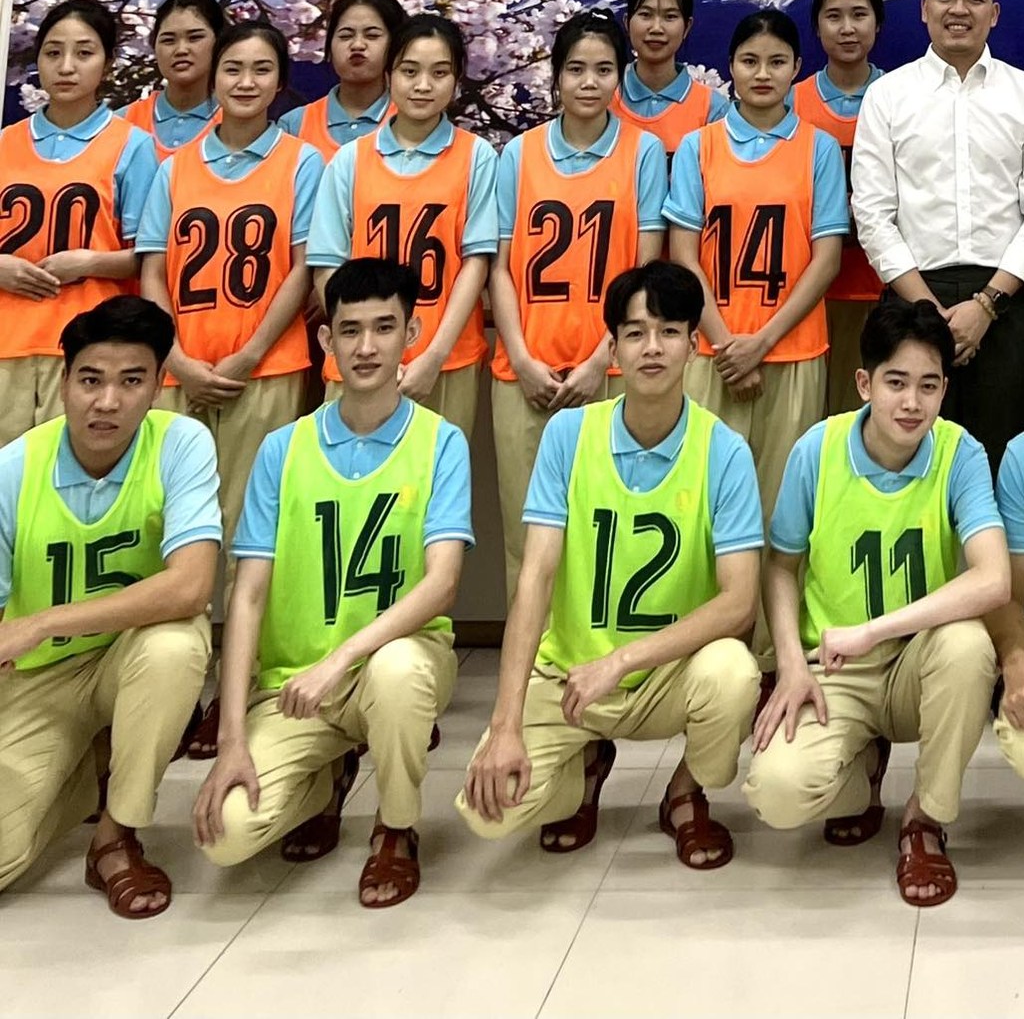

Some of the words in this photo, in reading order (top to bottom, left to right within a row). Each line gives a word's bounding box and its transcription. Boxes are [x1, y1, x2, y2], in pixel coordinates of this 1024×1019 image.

[0, 183, 100, 283] 20
[176, 204, 278, 312] 28
[367, 203, 448, 306] 16
[527, 200, 614, 304] 21
[703, 204, 787, 306] 14
[46, 529, 144, 646] 15
[315, 492, 405, 625] 14
[592, 508, 681, 632] 12
[850, 528, 927, 636] 11
